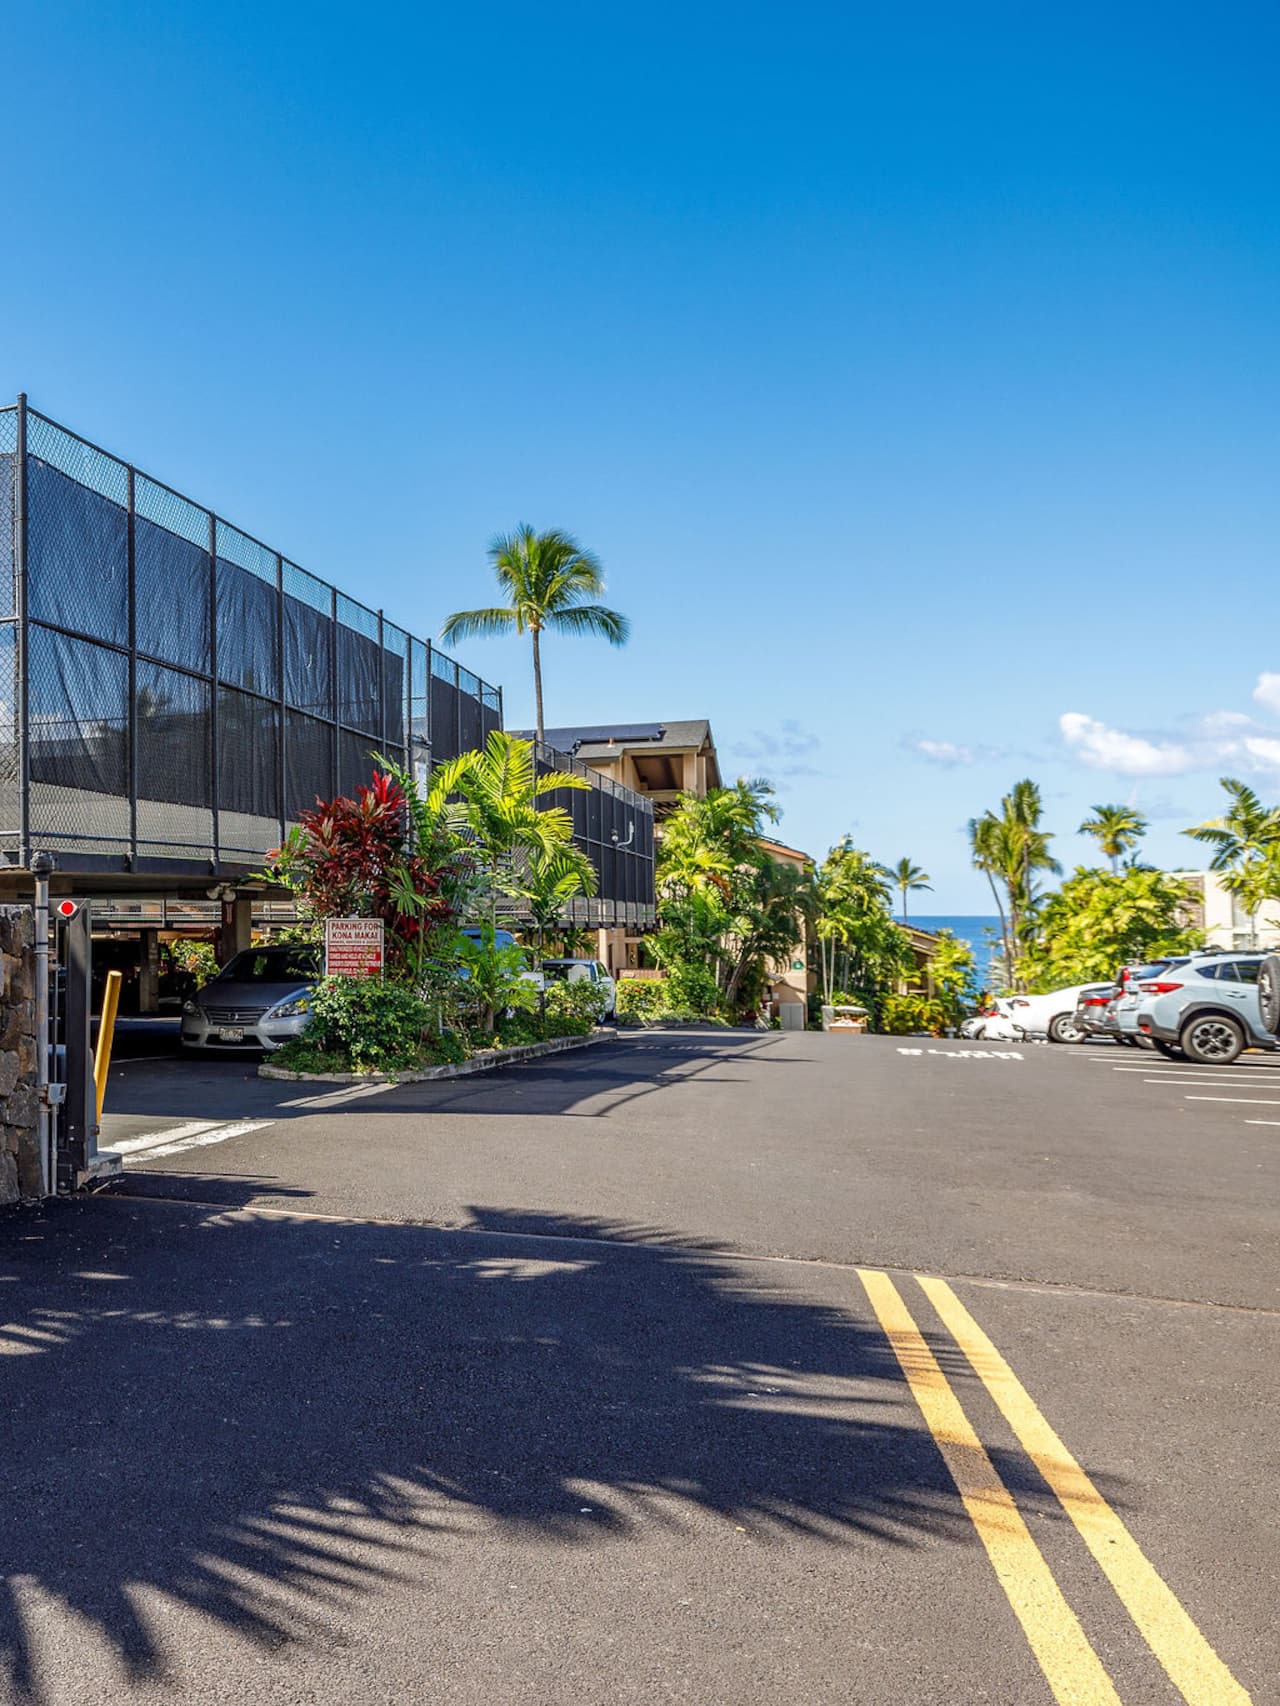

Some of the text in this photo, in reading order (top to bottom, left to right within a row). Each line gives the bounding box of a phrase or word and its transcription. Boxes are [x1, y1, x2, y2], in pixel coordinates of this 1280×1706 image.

[331, 922, 378, 930] PARKING FOR
[332, 931, 378, 939] KONA MAKAI
